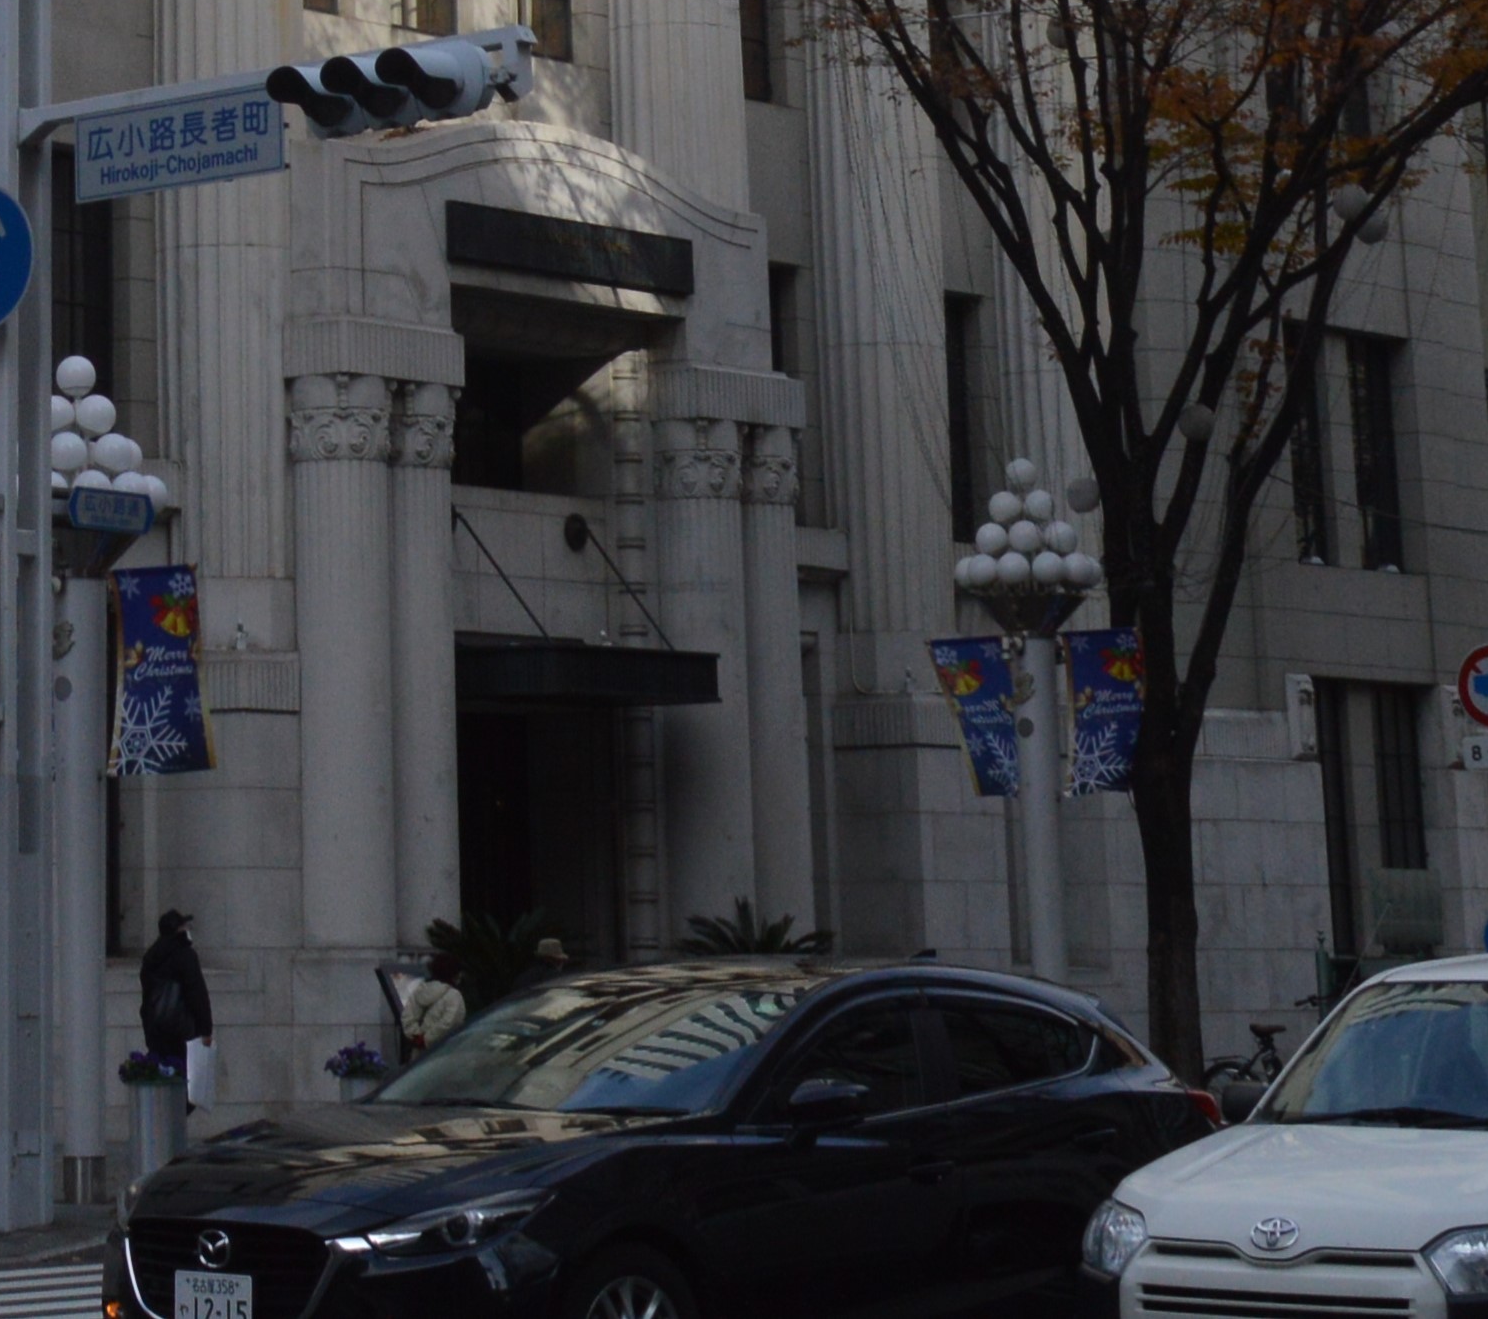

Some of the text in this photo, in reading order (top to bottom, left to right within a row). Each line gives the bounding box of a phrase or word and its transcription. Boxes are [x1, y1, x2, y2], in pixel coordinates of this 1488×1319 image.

[87, 100, 270, 161] 広小路長者町
[100, 143, 258, 185] Hirokoji-Chojamachi
[145, 646, 188, 662] Merry
[134, 662, 194, 681] Christmas
[1093, 688, 1135, 702] Merry
